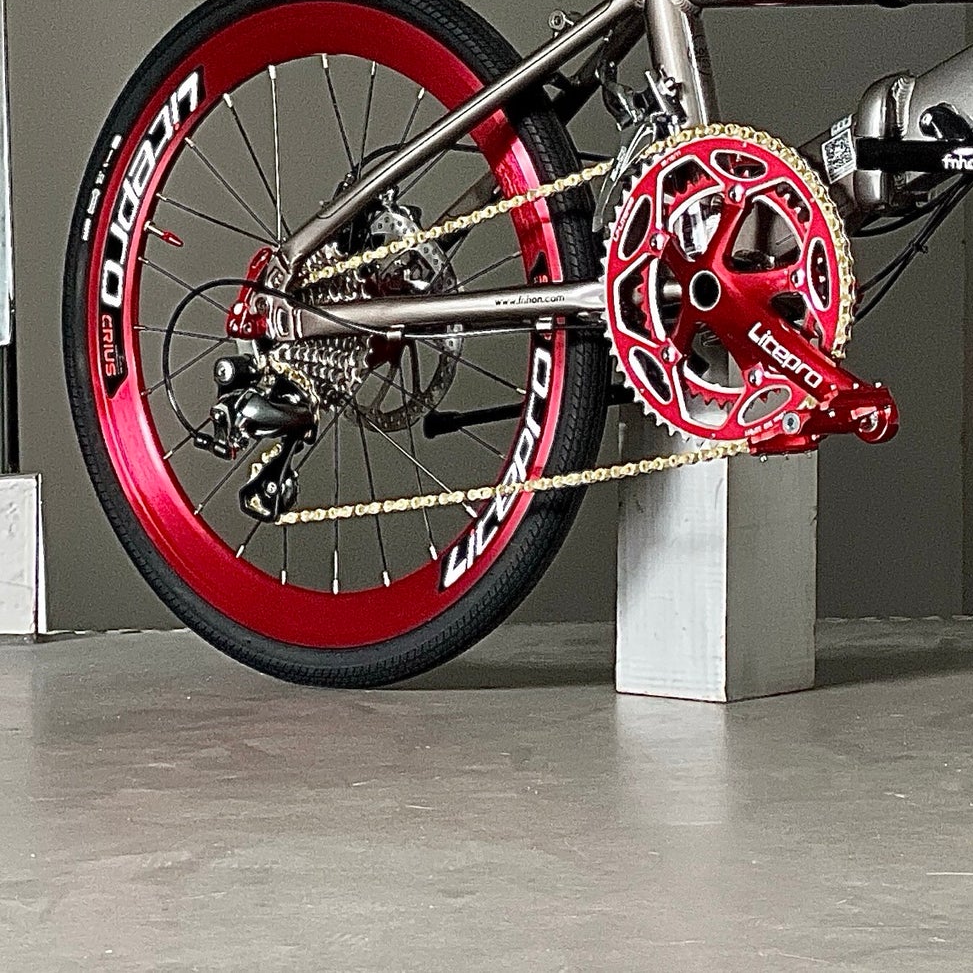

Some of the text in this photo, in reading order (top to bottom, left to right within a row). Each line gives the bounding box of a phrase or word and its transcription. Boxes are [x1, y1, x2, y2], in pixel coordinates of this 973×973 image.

[102, 71, 199, 308] Litepro
[102, 314, 116, 376] CRIUS
[747, 322, 823, 388] Litepro
